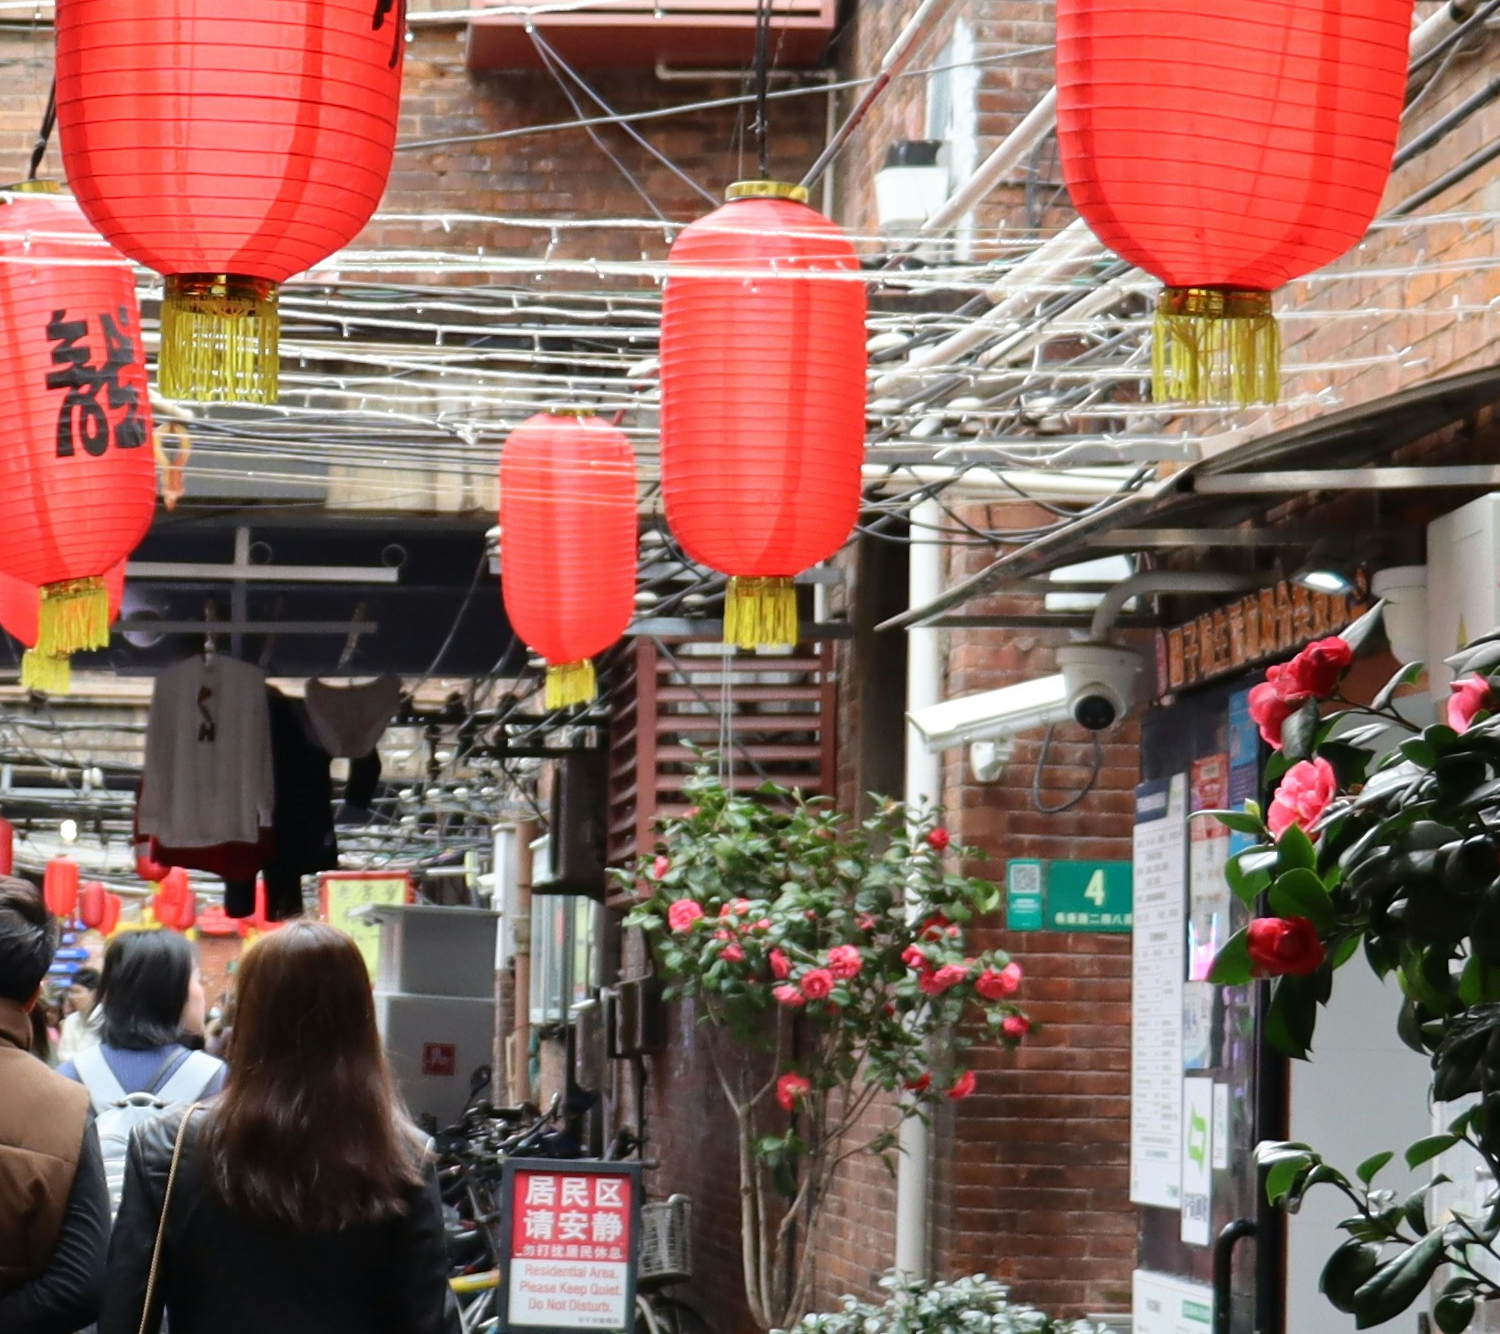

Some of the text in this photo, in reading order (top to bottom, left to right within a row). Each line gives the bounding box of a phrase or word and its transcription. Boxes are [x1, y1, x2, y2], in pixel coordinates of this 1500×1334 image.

[1084, 869, 1105, 906] 4
[524, 1175, 623, 1207] 居民区
[523, 1209, 623, 1242] 请安静
[525, 1264, 618, 1278] Residential Area.
[519, 1280, 622, 1296] Please Keep Quiet.
[528, 1298, 613, 1312] Do Not Disturb.
